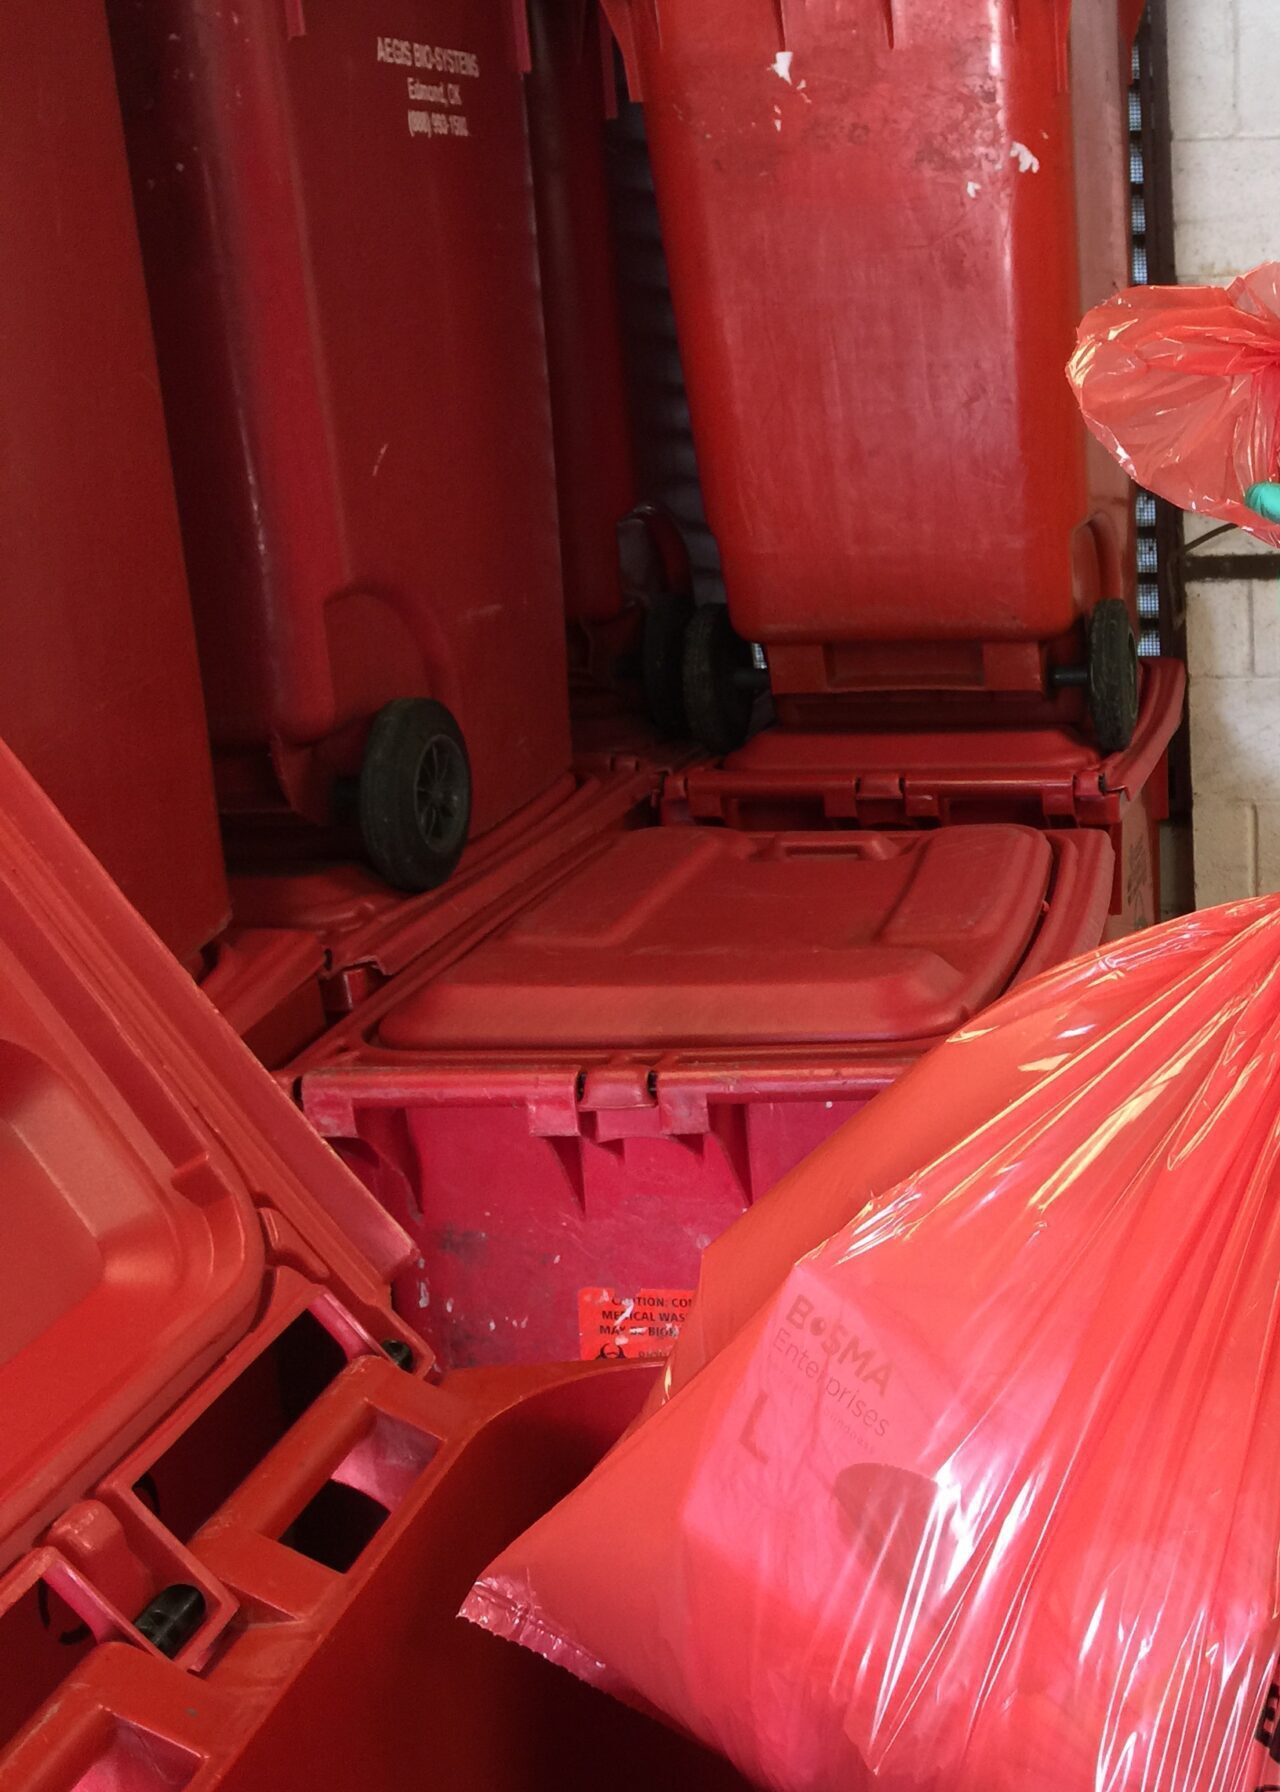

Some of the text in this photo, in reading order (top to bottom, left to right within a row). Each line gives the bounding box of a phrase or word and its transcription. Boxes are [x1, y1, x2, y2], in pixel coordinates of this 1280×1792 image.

[377, 36, 412, 66] AEGIS
[611, 1297, 667, 1307] CTION:
[658, 1312, 688, 1323] WAS
